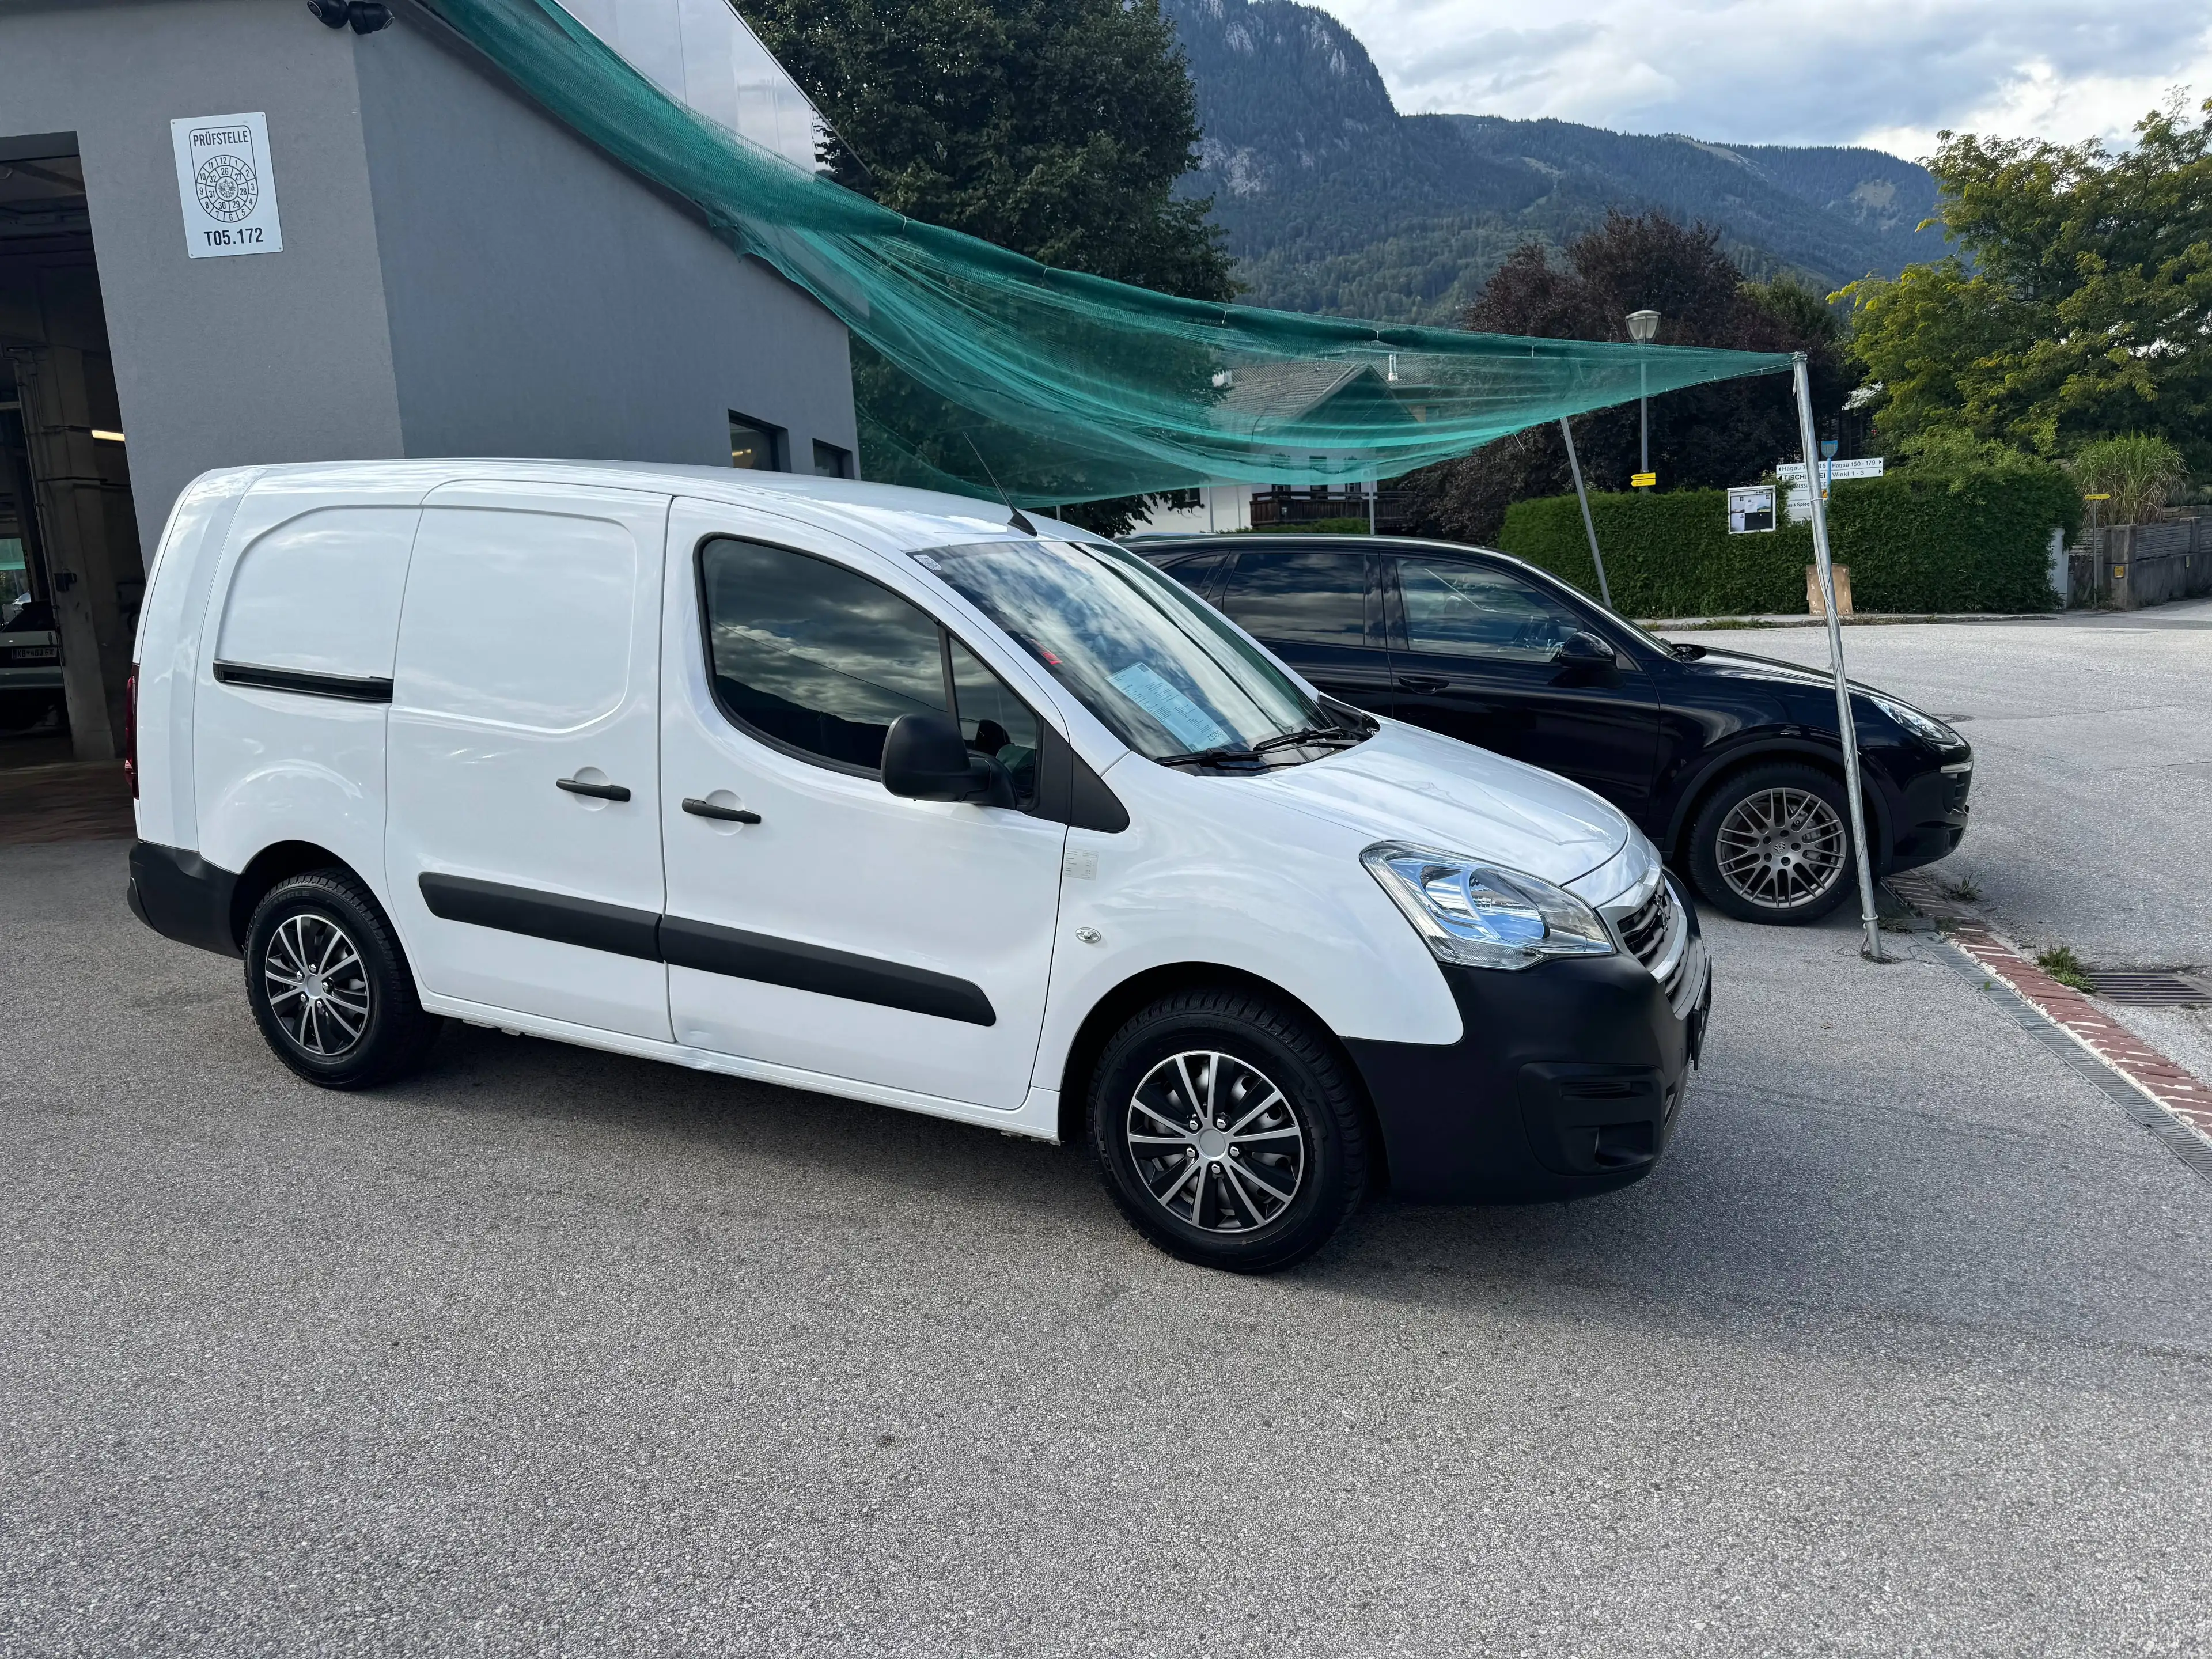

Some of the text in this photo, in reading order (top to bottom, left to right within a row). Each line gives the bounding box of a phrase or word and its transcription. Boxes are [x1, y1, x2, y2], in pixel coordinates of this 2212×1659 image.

[193, 130, 249, 147] PRÜFSTELLE
[208, 161, 214, 169] 11
[219, 157, 227, 165] 12
[221, 167, 229, 175] 26
[200, 173, 206, 181] 10
[234, 173, 241, 181] 27
[203, 227, 264, 246] T05.172
